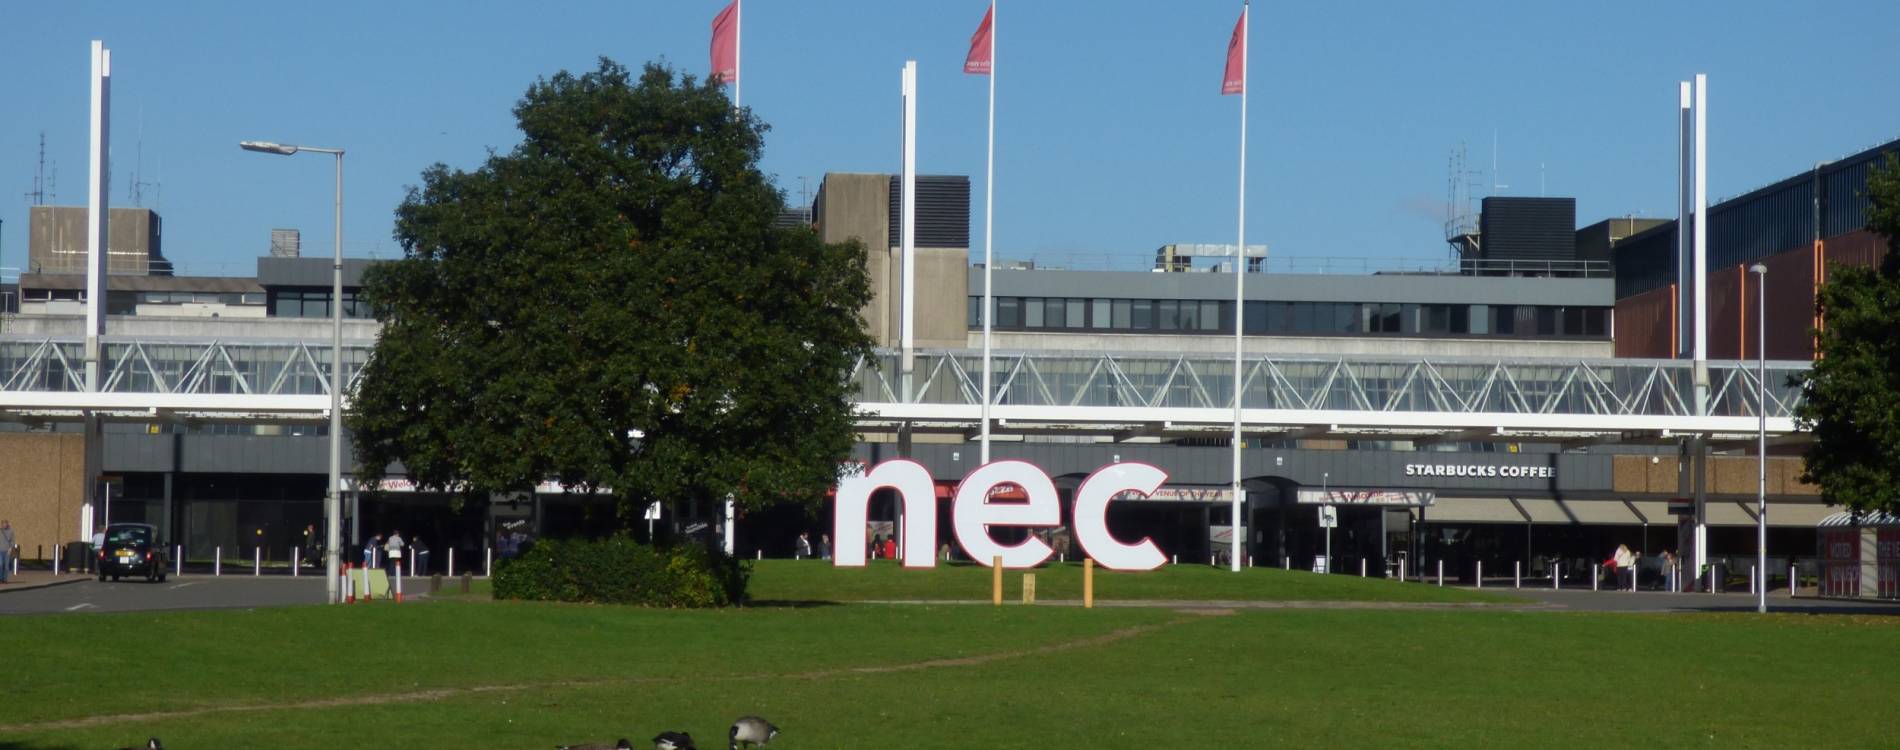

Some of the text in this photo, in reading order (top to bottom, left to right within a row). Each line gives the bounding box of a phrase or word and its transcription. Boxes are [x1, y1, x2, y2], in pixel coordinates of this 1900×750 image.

[1406, 464, 1556, 478] STARBUCKS COFFEE
[833, 459, 1169, 572] nec
